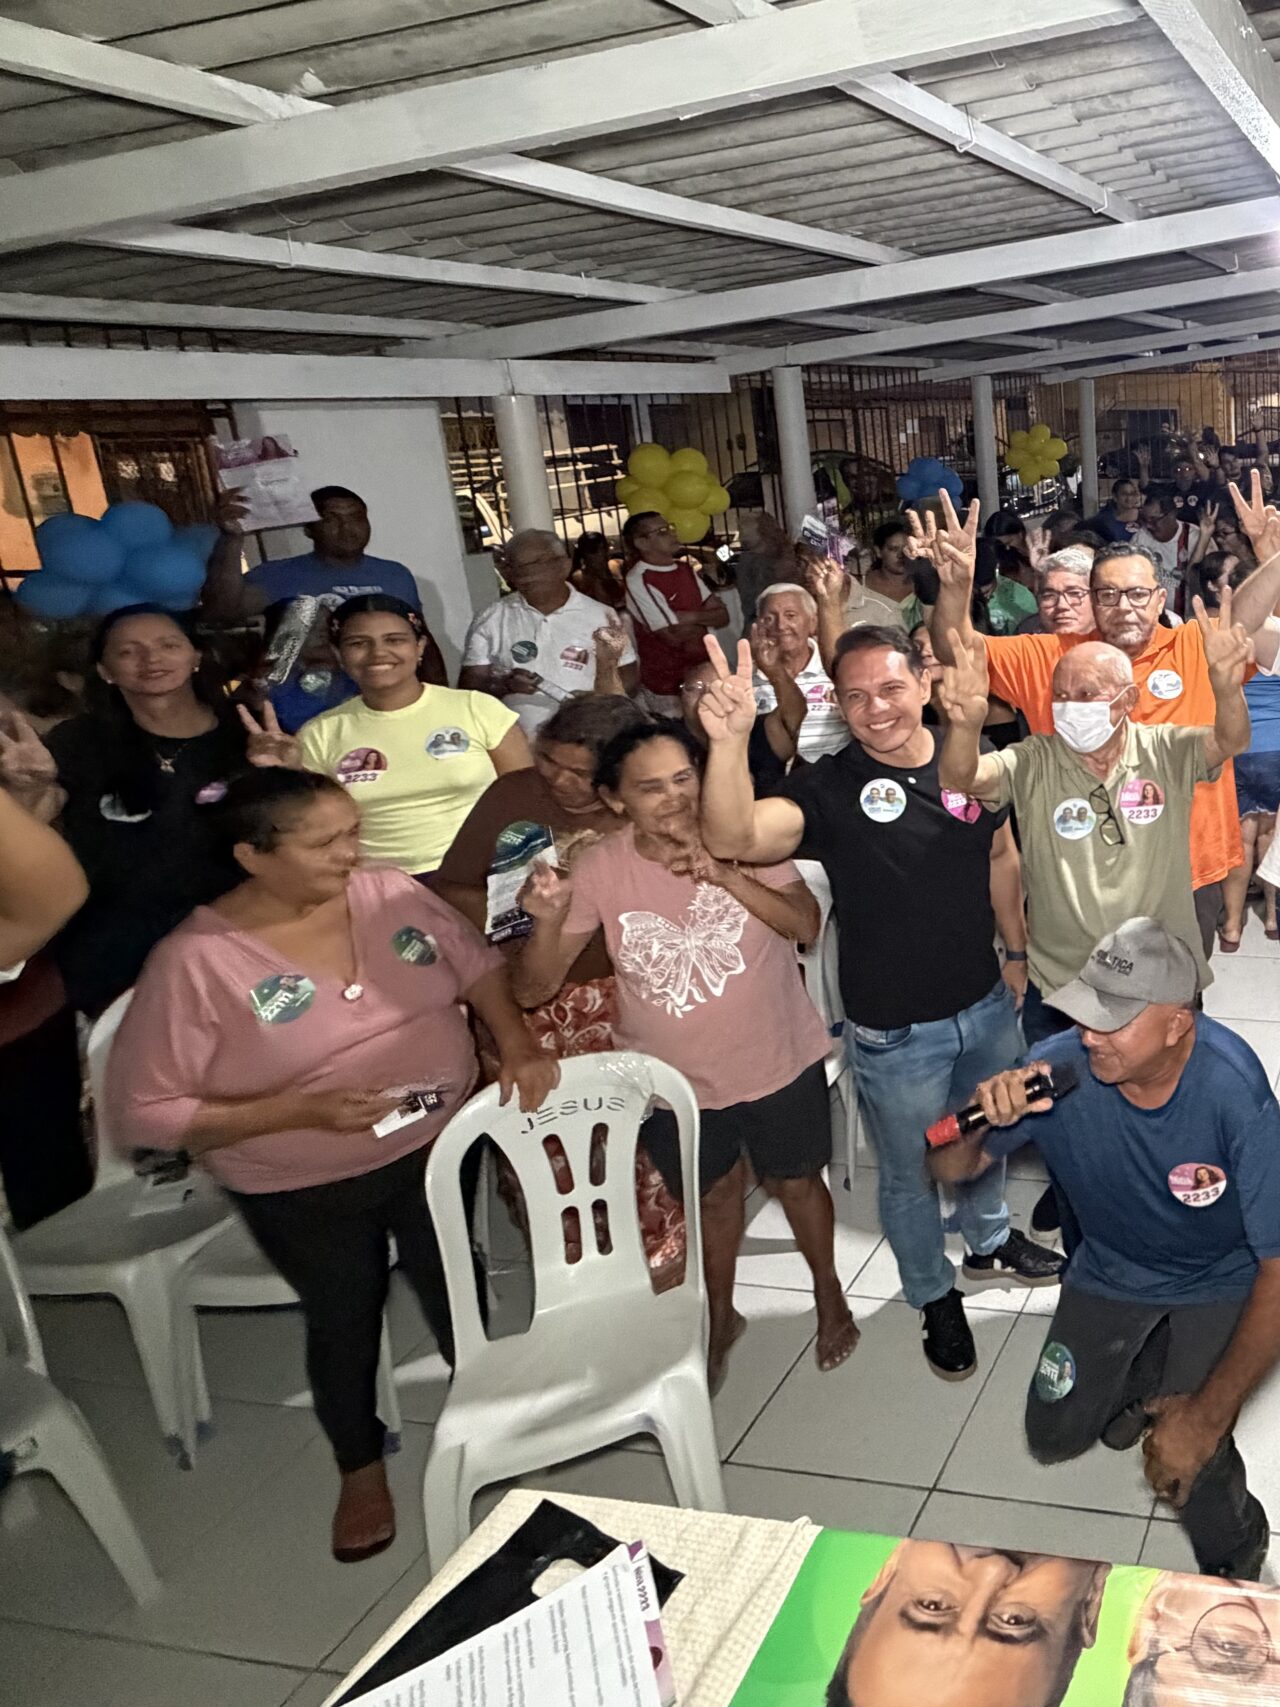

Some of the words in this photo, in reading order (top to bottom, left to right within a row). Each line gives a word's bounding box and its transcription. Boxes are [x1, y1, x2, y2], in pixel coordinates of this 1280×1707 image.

[1127, 808, 1159, 820] 2233
[521, 1096, 625, 1134] JESUS
[1182, 1187, 1219, 1203] 2233
